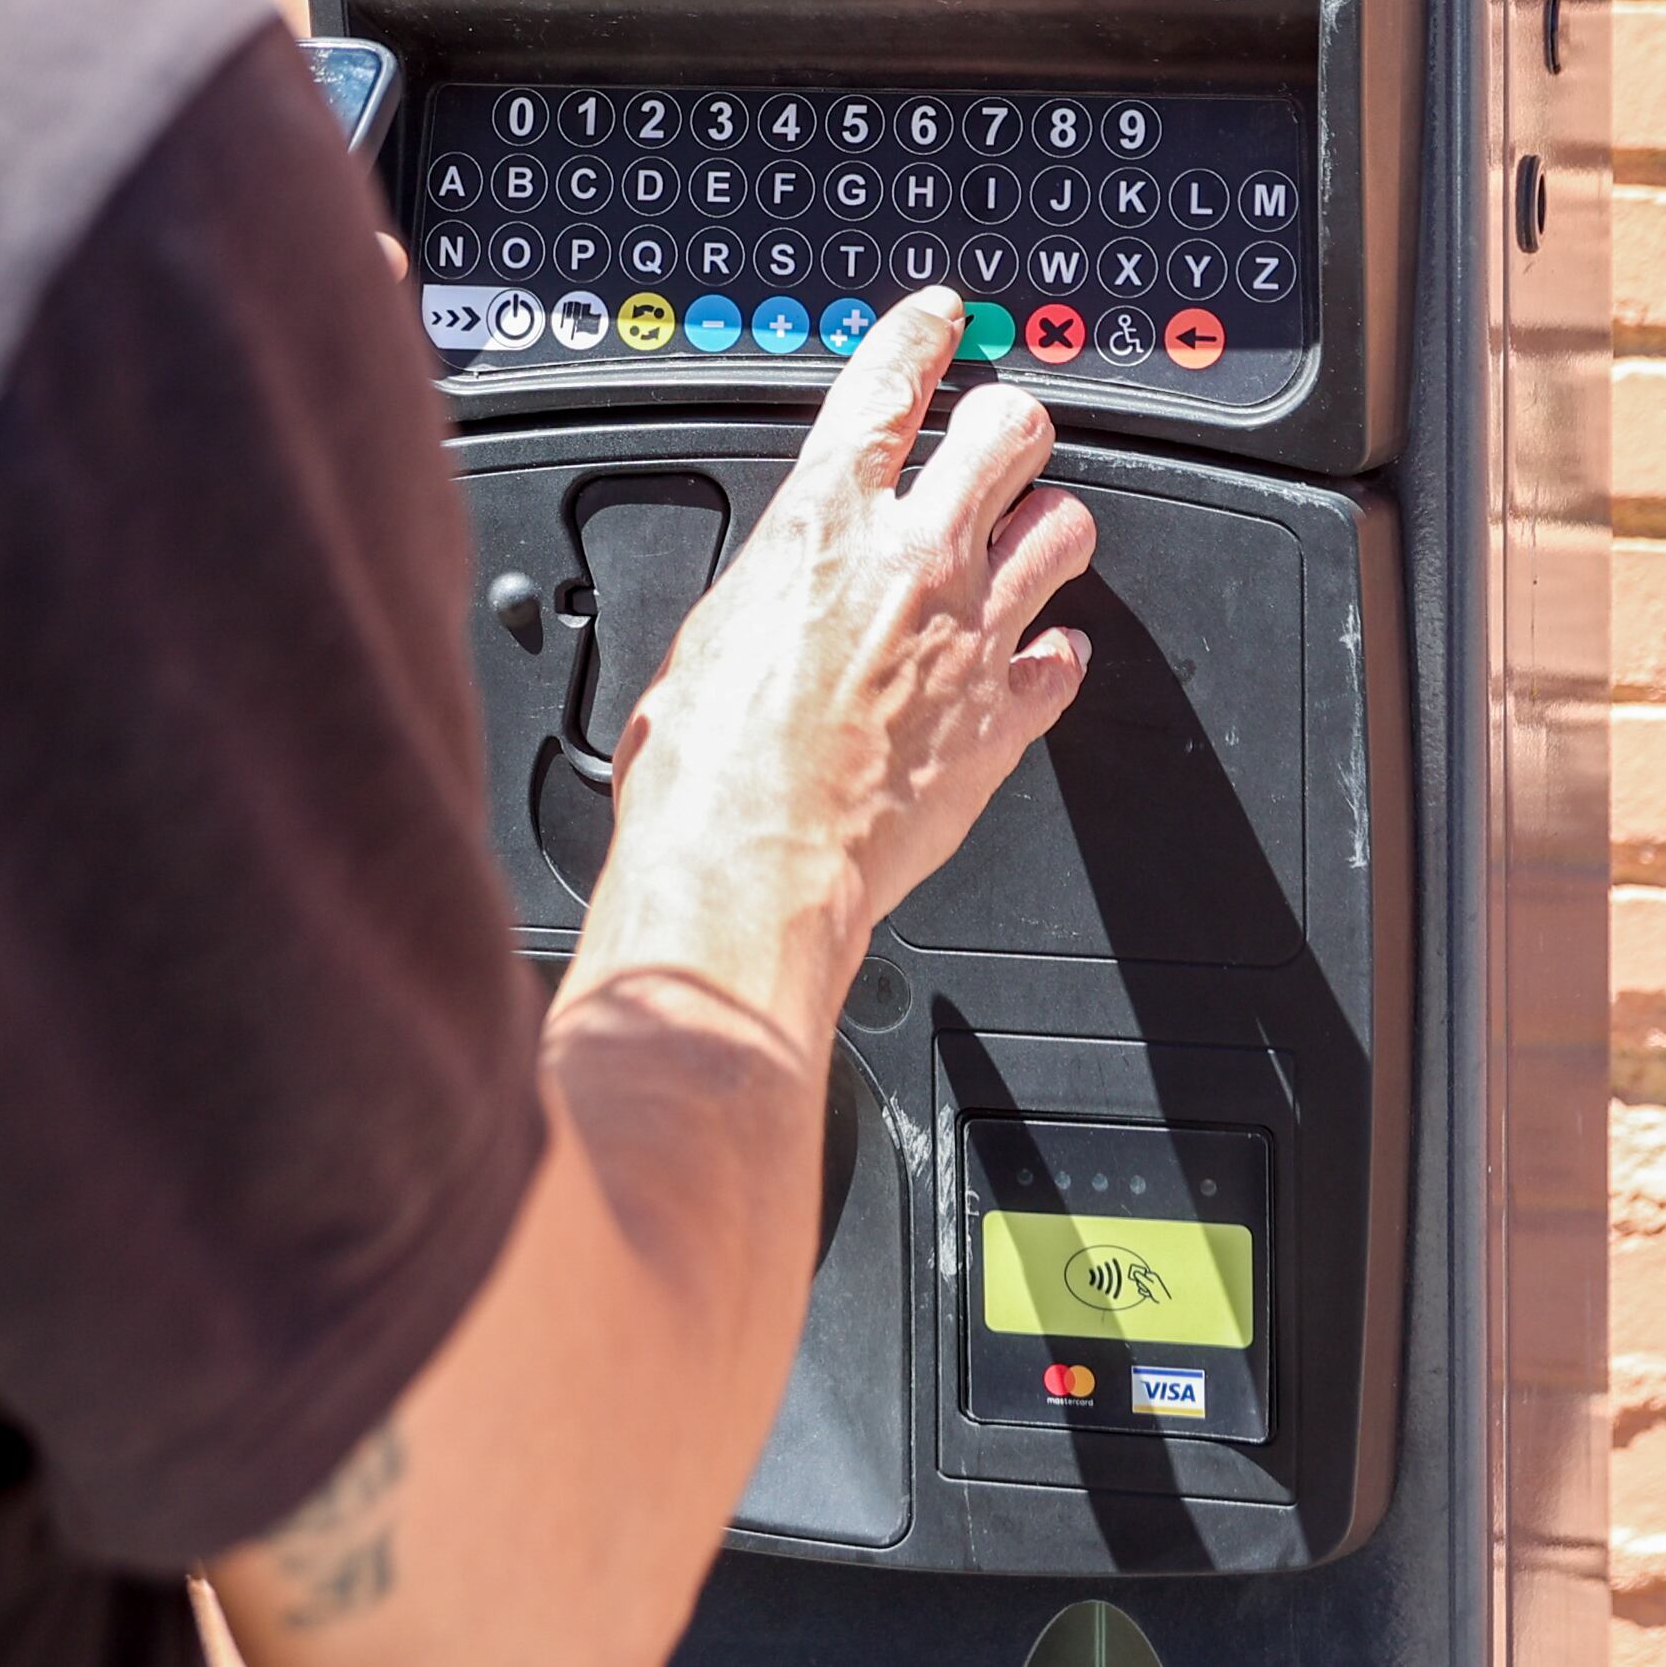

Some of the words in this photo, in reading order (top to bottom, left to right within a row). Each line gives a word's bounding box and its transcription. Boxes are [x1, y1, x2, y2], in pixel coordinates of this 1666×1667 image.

[509, 97, 534, 137] 0
[578, 97, 596, 136] 1
[639, 99, 665, 139] 2
[707, 101, 734, 141] 3
[772, 103, 801, 142] 4
[842, 104, 869, 144] 5
[911, 105, 937, 145] 6
[982, 107, 1008, 146] 7
[1050, 108, 1077, 148] 8
[1119, 109, 1146, 150] 9
[438, 165, 466, 197] A
[508, 166, 534, 198] B
[570, 168, 597, 200] C
[637, 169, 664, 201] D
[707, 171, 731, 203] E
[773, 172, 796, 204] F
[837, 174, 866, 206] G
[908, 175, 934, 208] H
[987, 177, 996, 209] I
[1049, 179, 1072, 211] J
[1118, 180, 1147, 213] K
[1190, 182, 1213, 215] L
[1254, 184, 1286, 217] M
[439, 236, 464, 267] N
[502, 237, 531, 269] O
[571, 239, 595, 270] P
[632, 240, 662, 275] Q
[703, 242, 730, 274] R
[770, 243, 795, 276] S
[839, 245, 865, 277] T
[907, 247, 933, 279] U
[974, 249, 1003, 281] V
[1040, 251, 1076, 284] W
[1114, 253, 1142, 286] X
[1184, 255, 1212, 288] Y
[1252, 257, 1279, 290] Z
[1046, 1396, 1094, 1407] mastercard
[1141, 1381, 1196, 1403] VISA
